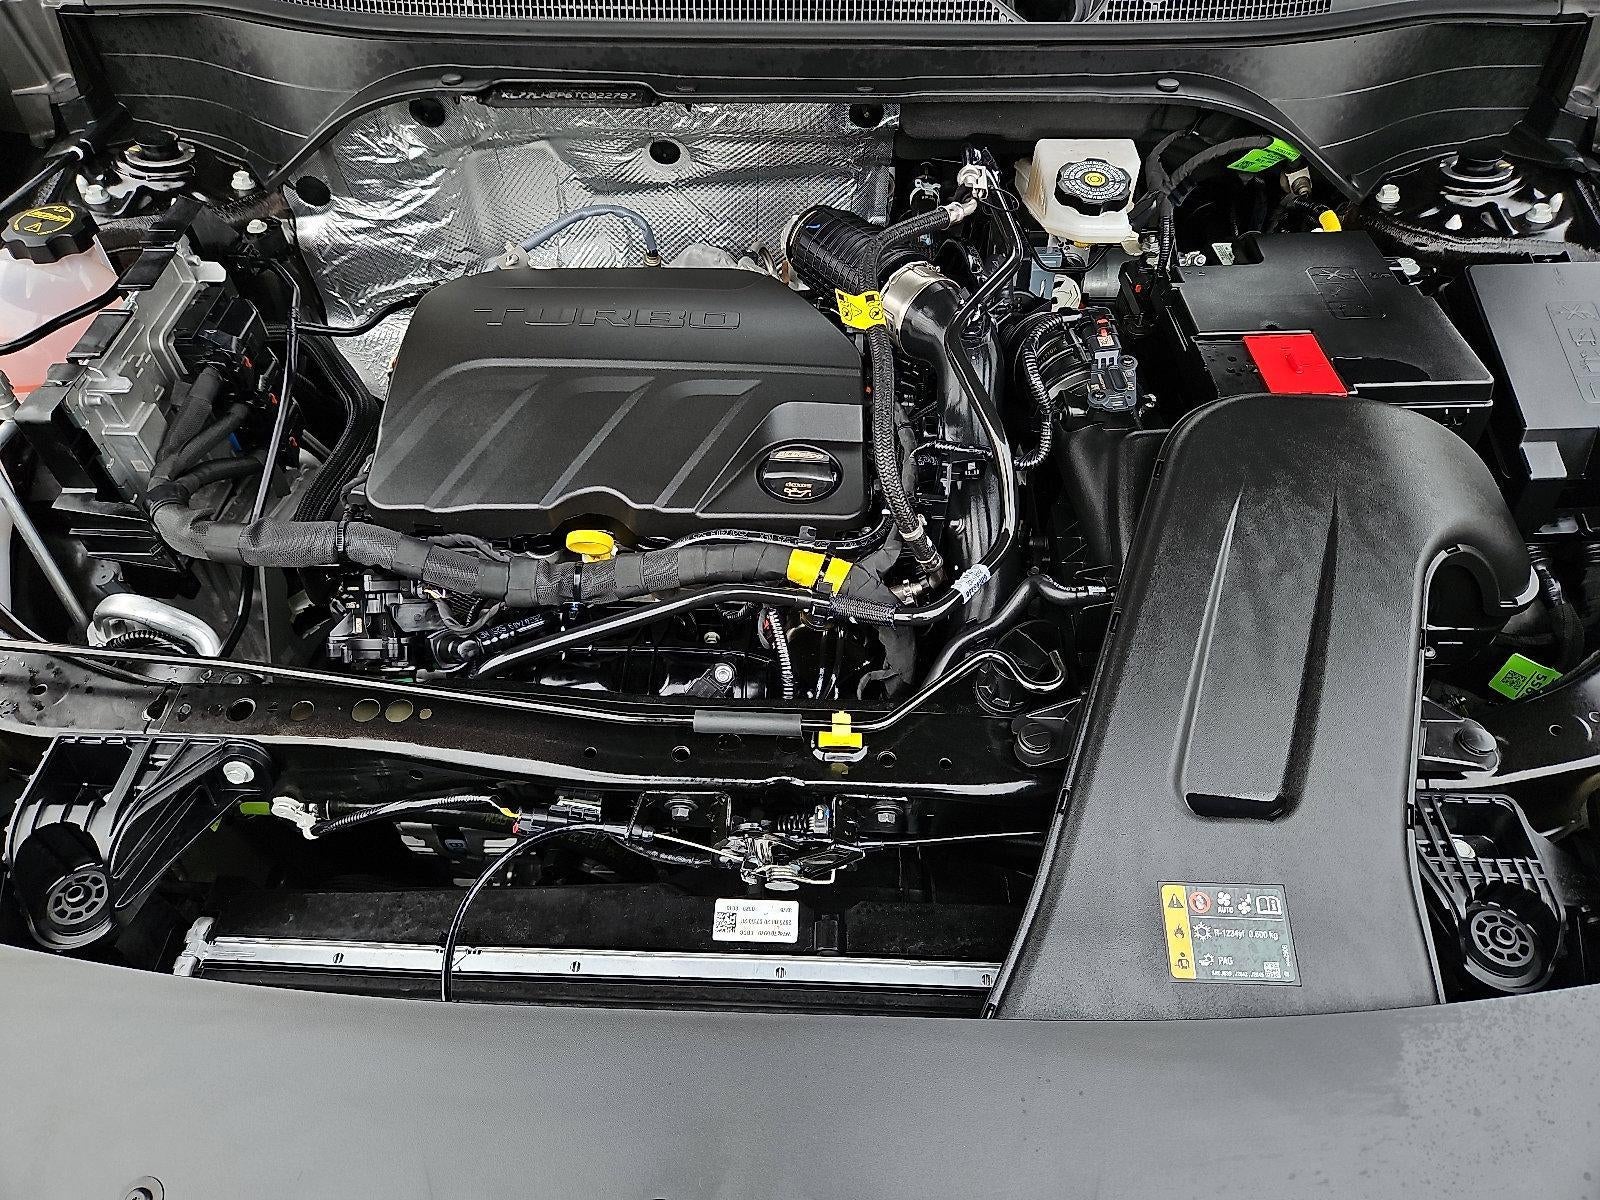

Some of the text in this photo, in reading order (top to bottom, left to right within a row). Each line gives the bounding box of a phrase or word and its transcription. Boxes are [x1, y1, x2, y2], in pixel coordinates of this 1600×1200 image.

[474, 308, 741, 330] TURBO
[1217, 906, 1234, 914] AUTO
[1218, 956, 1233, 965] PAG
